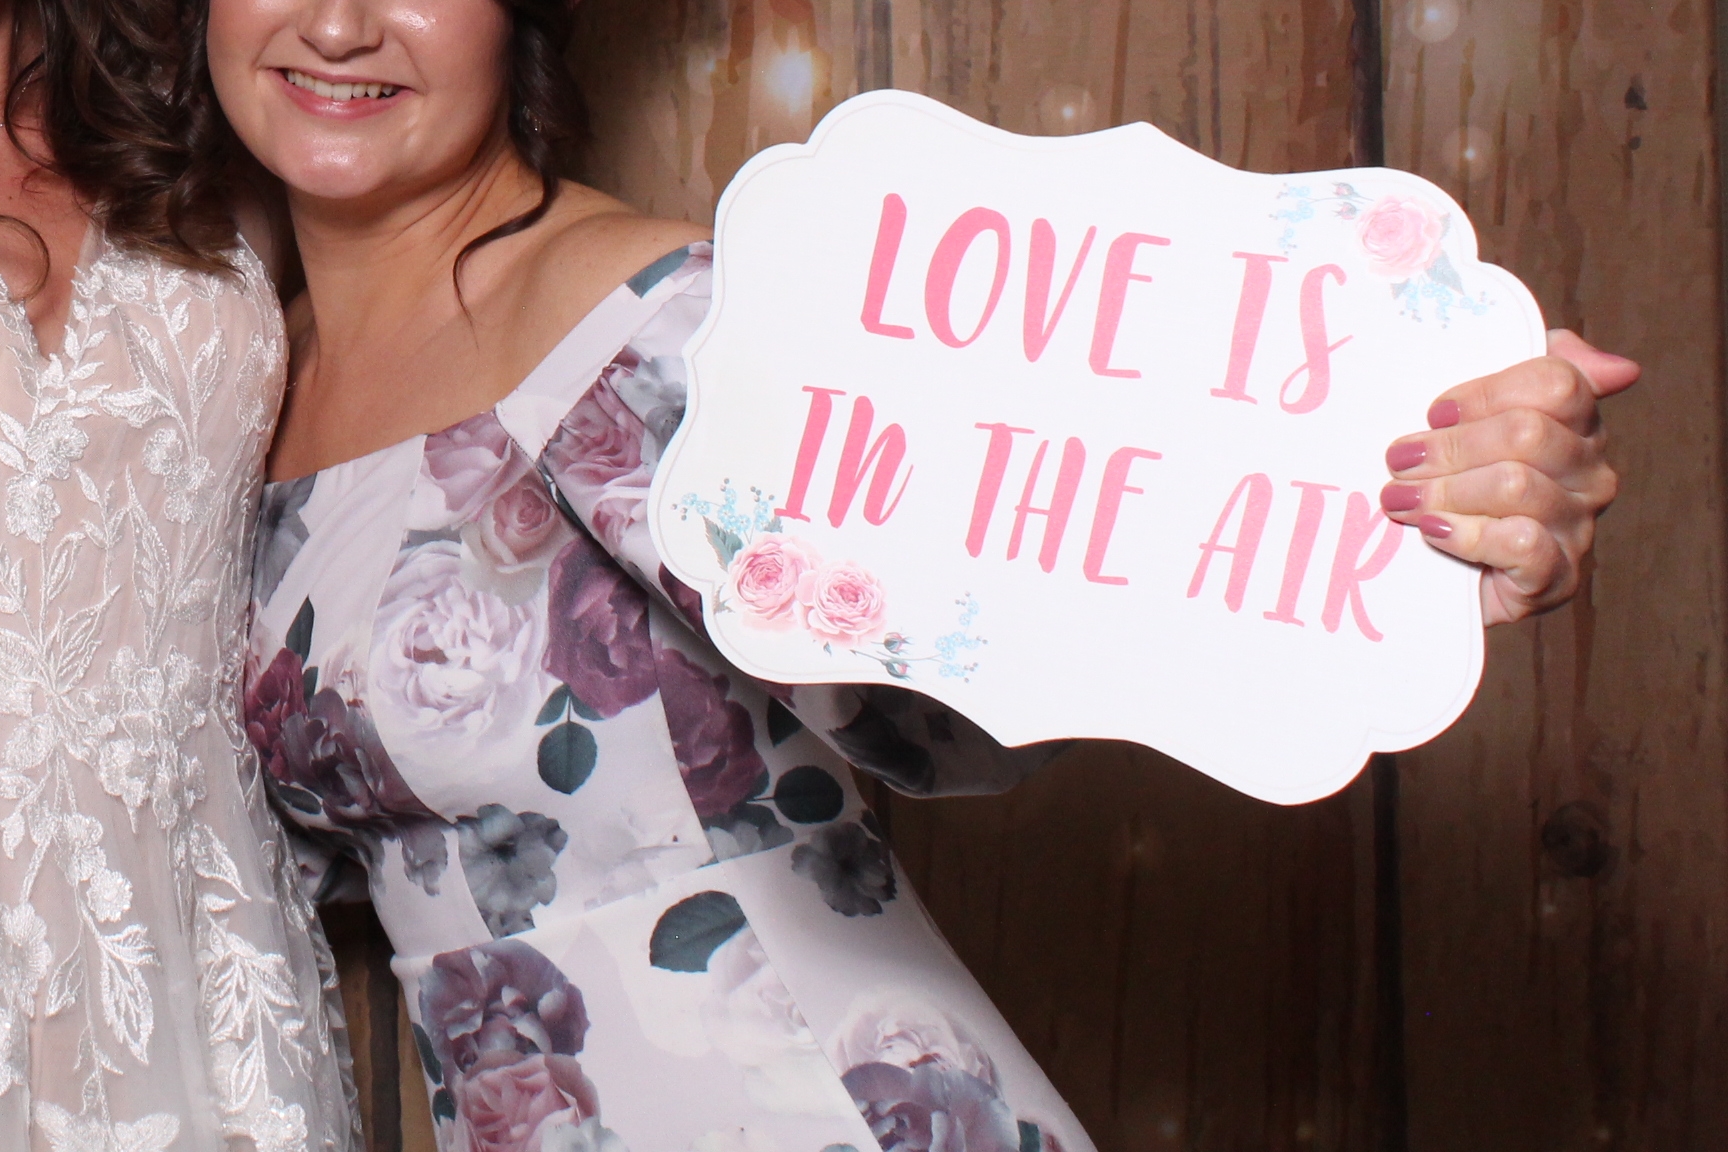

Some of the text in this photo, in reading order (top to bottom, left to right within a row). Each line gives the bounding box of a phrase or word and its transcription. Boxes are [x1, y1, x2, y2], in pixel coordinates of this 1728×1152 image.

[860, 193, 1353, 414] LOVE IS
[965, 422, 1162, 586] THE
[1187, 473, 1407, 642] AIR
